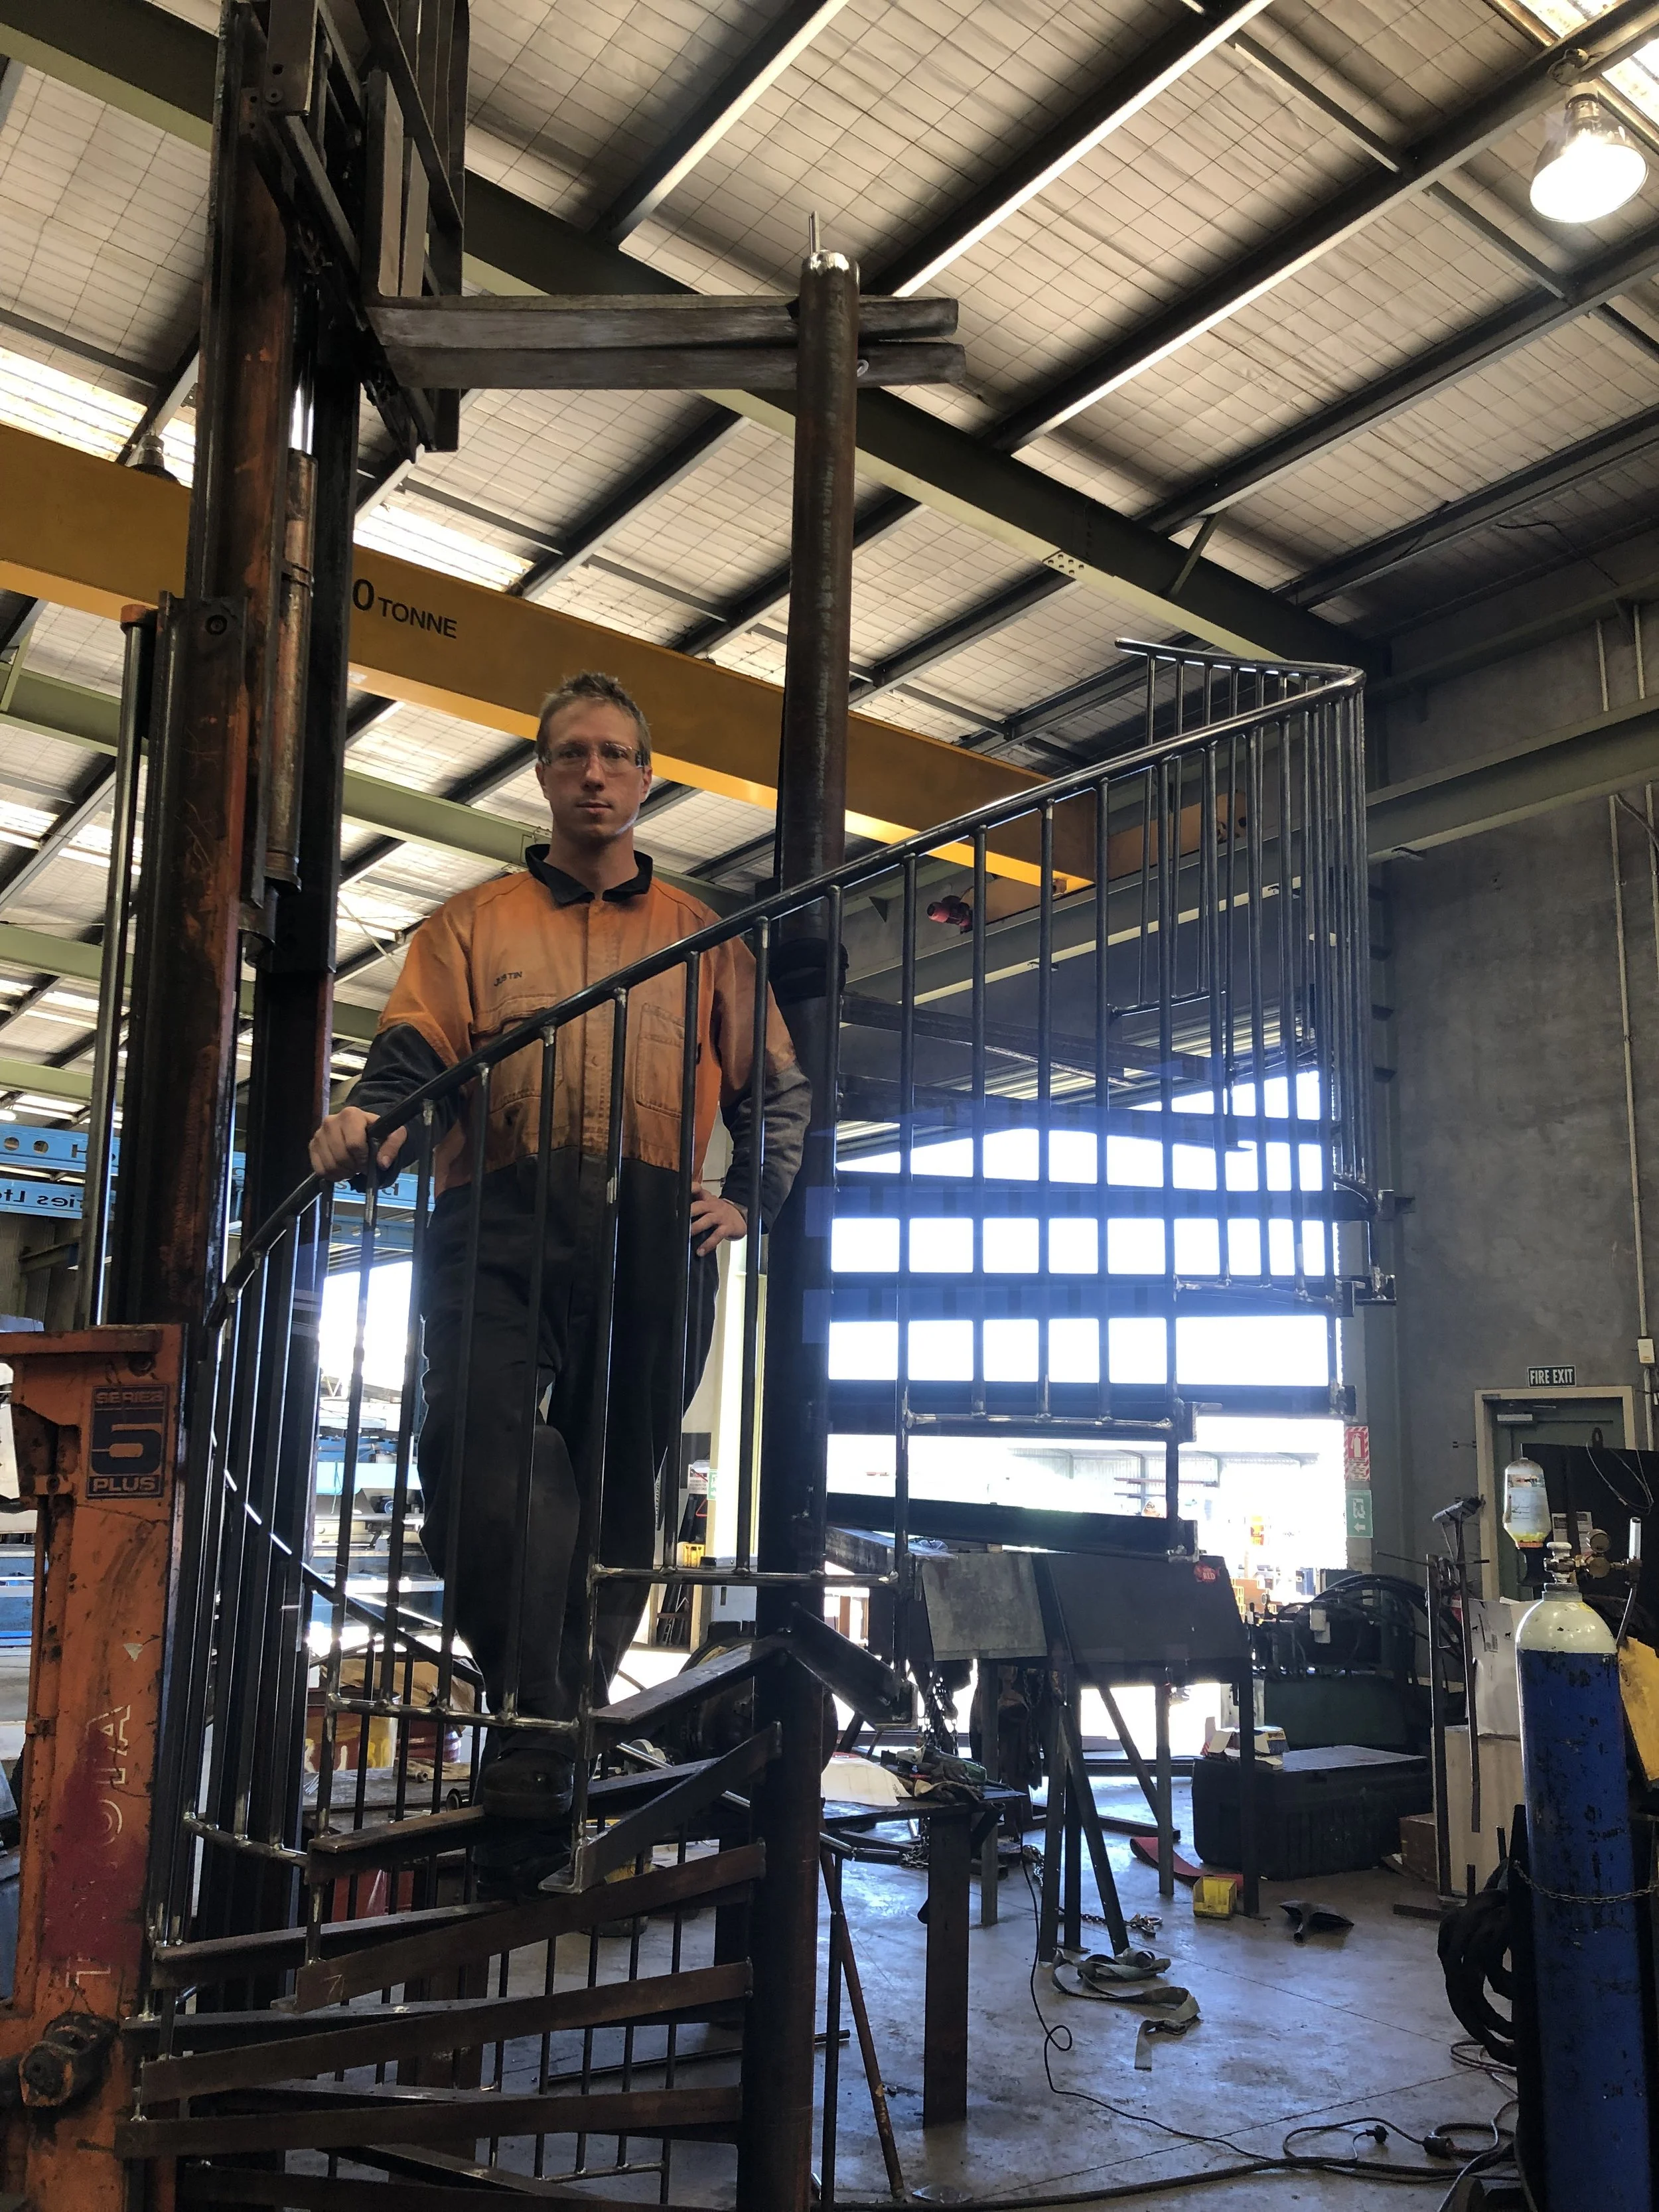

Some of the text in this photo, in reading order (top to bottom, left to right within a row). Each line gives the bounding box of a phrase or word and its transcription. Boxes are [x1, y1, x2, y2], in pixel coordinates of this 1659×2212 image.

[378, 597, 457, 638] TONNE
[494, 971, 522, 986] JUSTIN
[1530, 1368, 1573, 1384] FIRE EXIT
[96, 1391, 164, 1404] SERIES
[93, 1477, 155, 1492] PLUS
